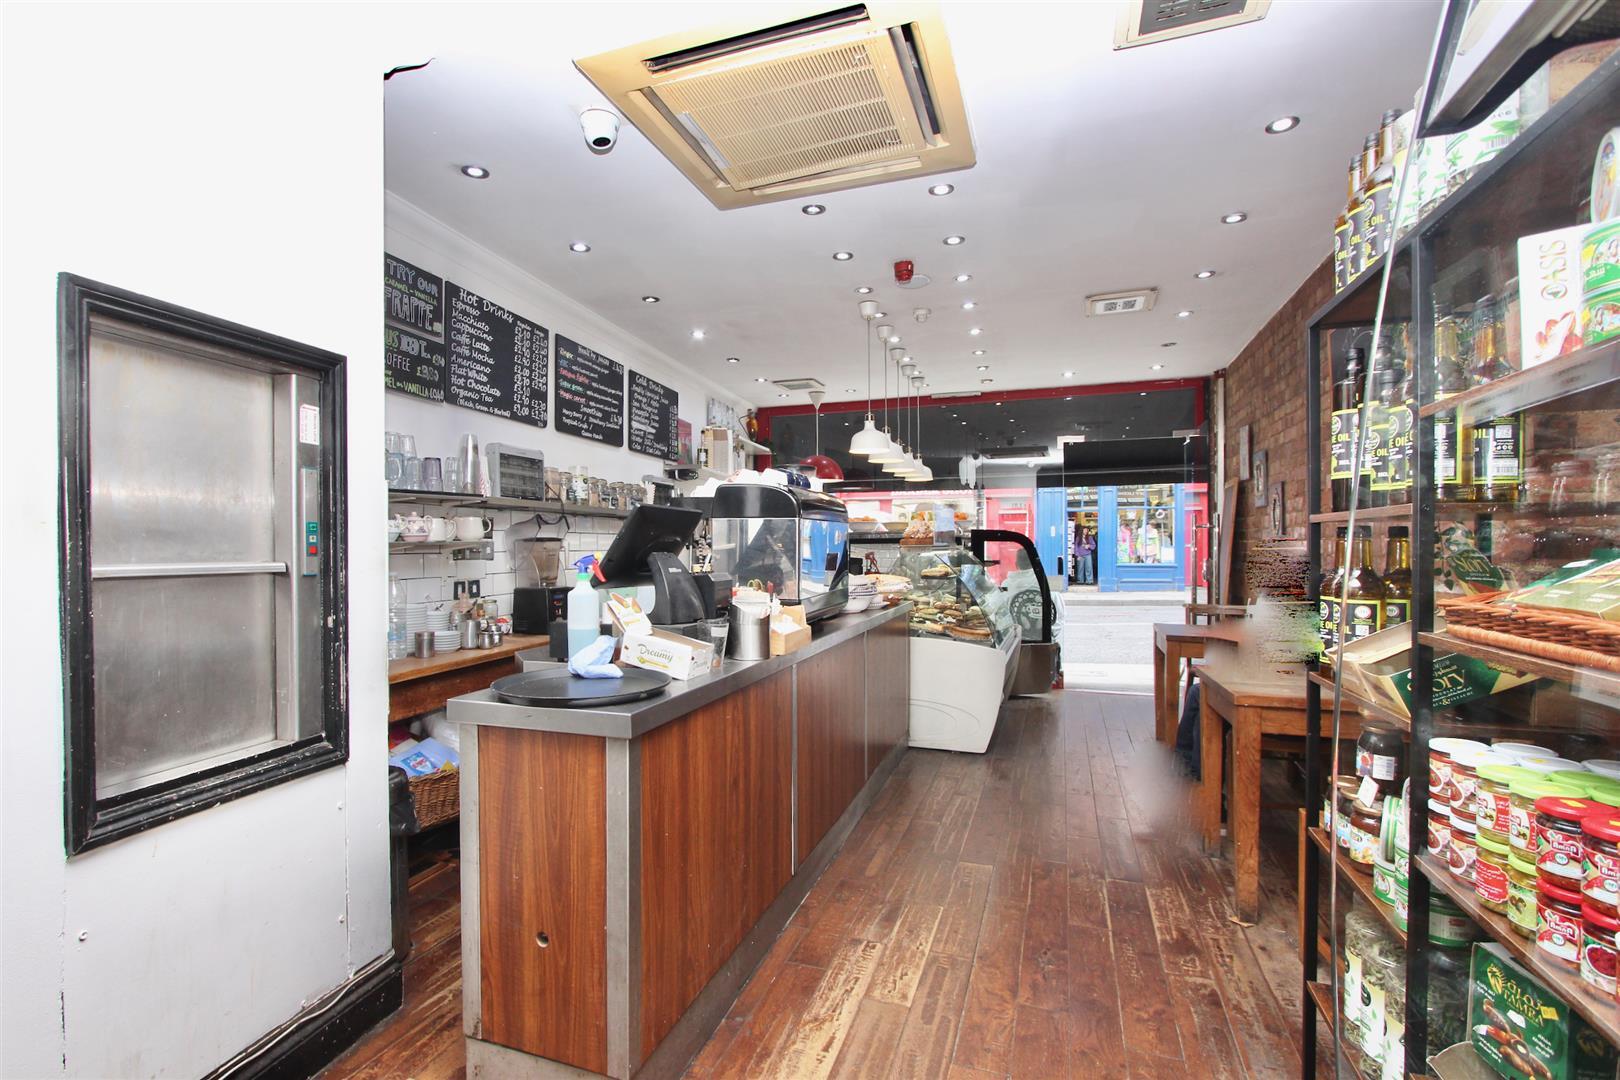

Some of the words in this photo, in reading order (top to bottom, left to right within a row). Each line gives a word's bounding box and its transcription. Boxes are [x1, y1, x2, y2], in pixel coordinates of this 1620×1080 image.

[387, 259, 415, 284] TRY
[418, 277, 438, 297] OUR
[452, 297, 480, 316] Espresso
[459, 289, 479, 306] Hot
[483, 300, 514, 323] Drinks
[452, 308, 490, 332] Macchiato
[451, 318, 494, 342] Cappuccino
[472, 338, 491, 352] Latte
[387, 352, 411, 372] OFFEE
[450, 353, 491, 373] Americano
[471, 350, 495, 365] Mocha
[450, 364, 467, 375] Flat
[467, 368, 489, 382] White
[450, 374, 466, 386] Hot
[466, 379, 501, 397] Chocolate
[450, 386, 479, 400] Organic
[480, 393, 494, 403] Tea
[1337, 433, 1351, 442] OIL
[1376, 448, 1389, 457] OIL
